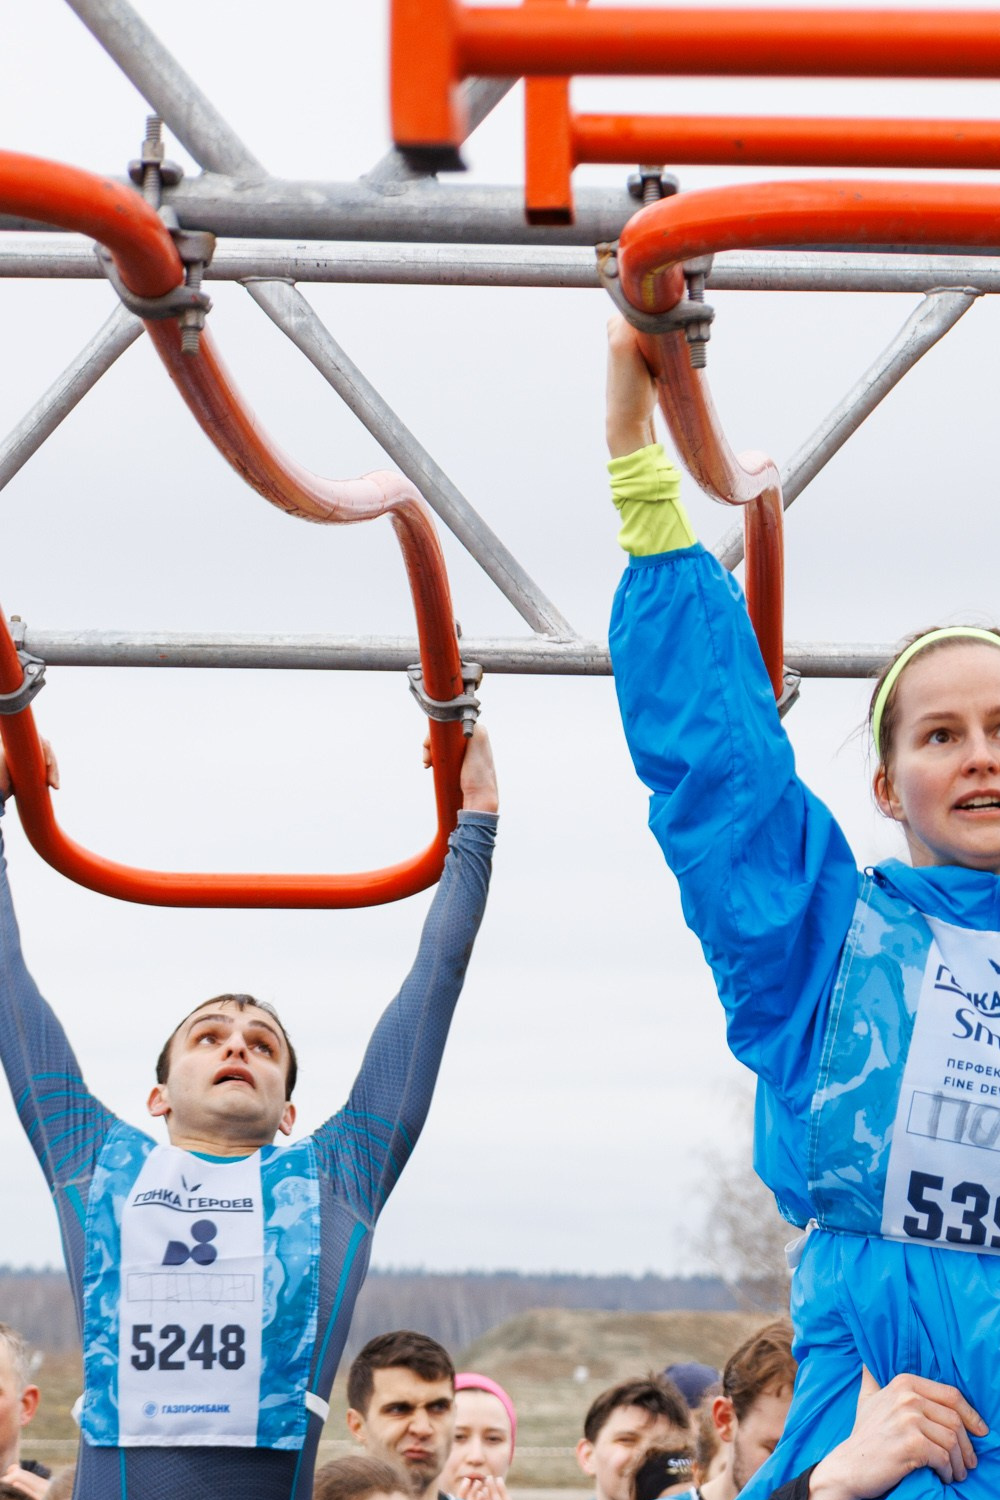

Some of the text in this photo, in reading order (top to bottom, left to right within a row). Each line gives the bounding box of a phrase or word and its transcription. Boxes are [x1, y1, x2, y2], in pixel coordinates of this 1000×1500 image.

[943, 1076, 974, 1091] FINE
[134, 1188, 254, 1209] ГОНКА ГЕРОЕВ
[131, 1324, 246, 1371] 5248
[161, 1404, 231, 1414] ГАЗПРОМБАНК
